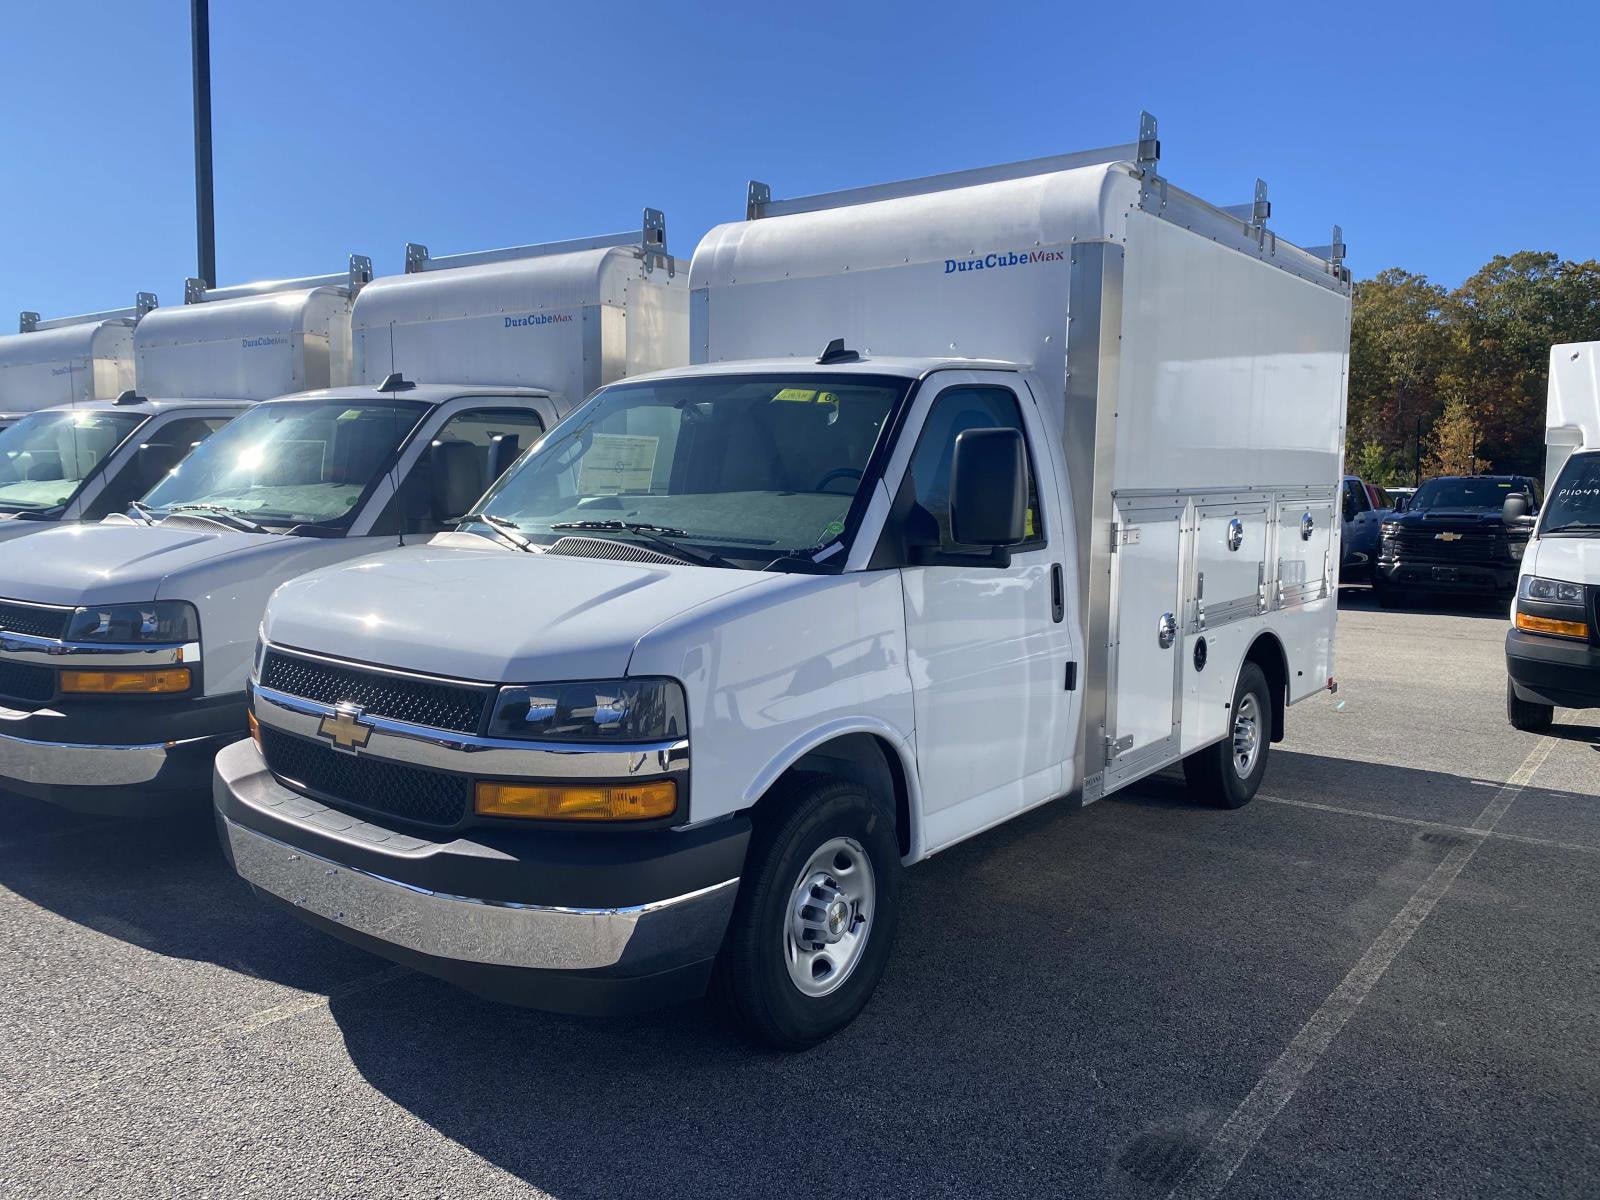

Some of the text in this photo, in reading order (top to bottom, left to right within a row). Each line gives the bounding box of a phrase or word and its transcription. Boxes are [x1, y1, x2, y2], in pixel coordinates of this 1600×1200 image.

[944, 250, 1065, 274] DuraCubeMax
[504, 312, 574, 328] DuraCubeMax
[1558, 488, 1600, 497] P11049
